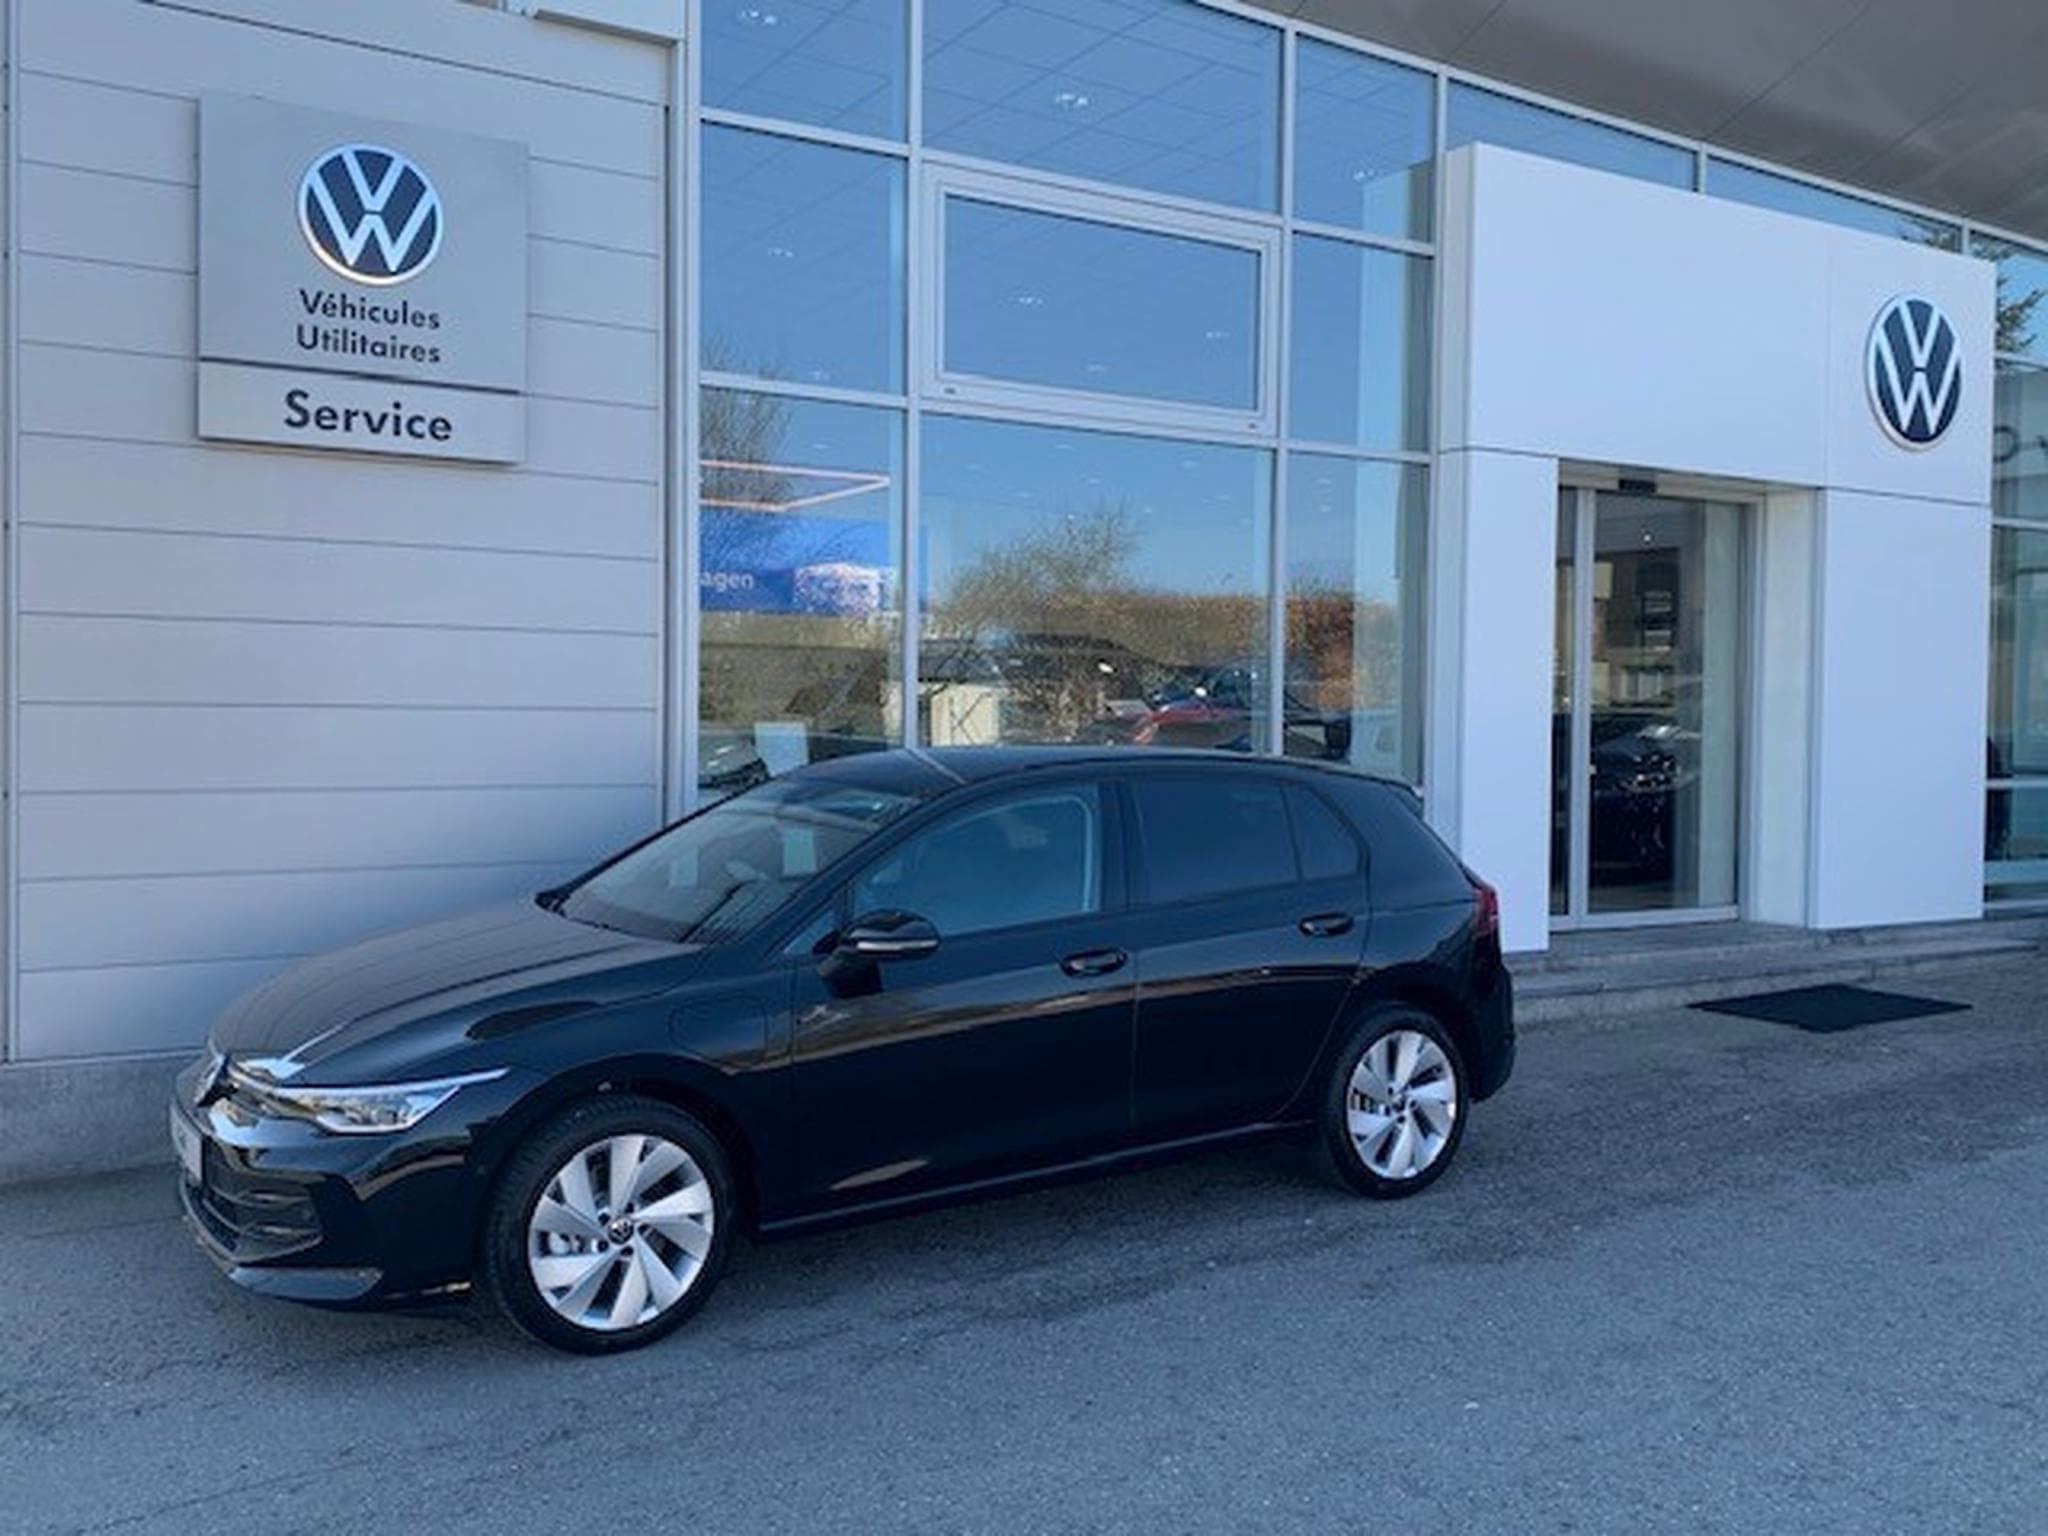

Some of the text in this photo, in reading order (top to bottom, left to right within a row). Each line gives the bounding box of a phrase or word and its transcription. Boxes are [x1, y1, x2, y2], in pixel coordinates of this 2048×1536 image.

[303, 146, 440, 275] VW
[300, 289, 441, 329] Véhicules
[297, 325, 440, 363] Utilitaires
[1873, 295, 1962, 440] VW
[284, 390, 452, 440] Service
